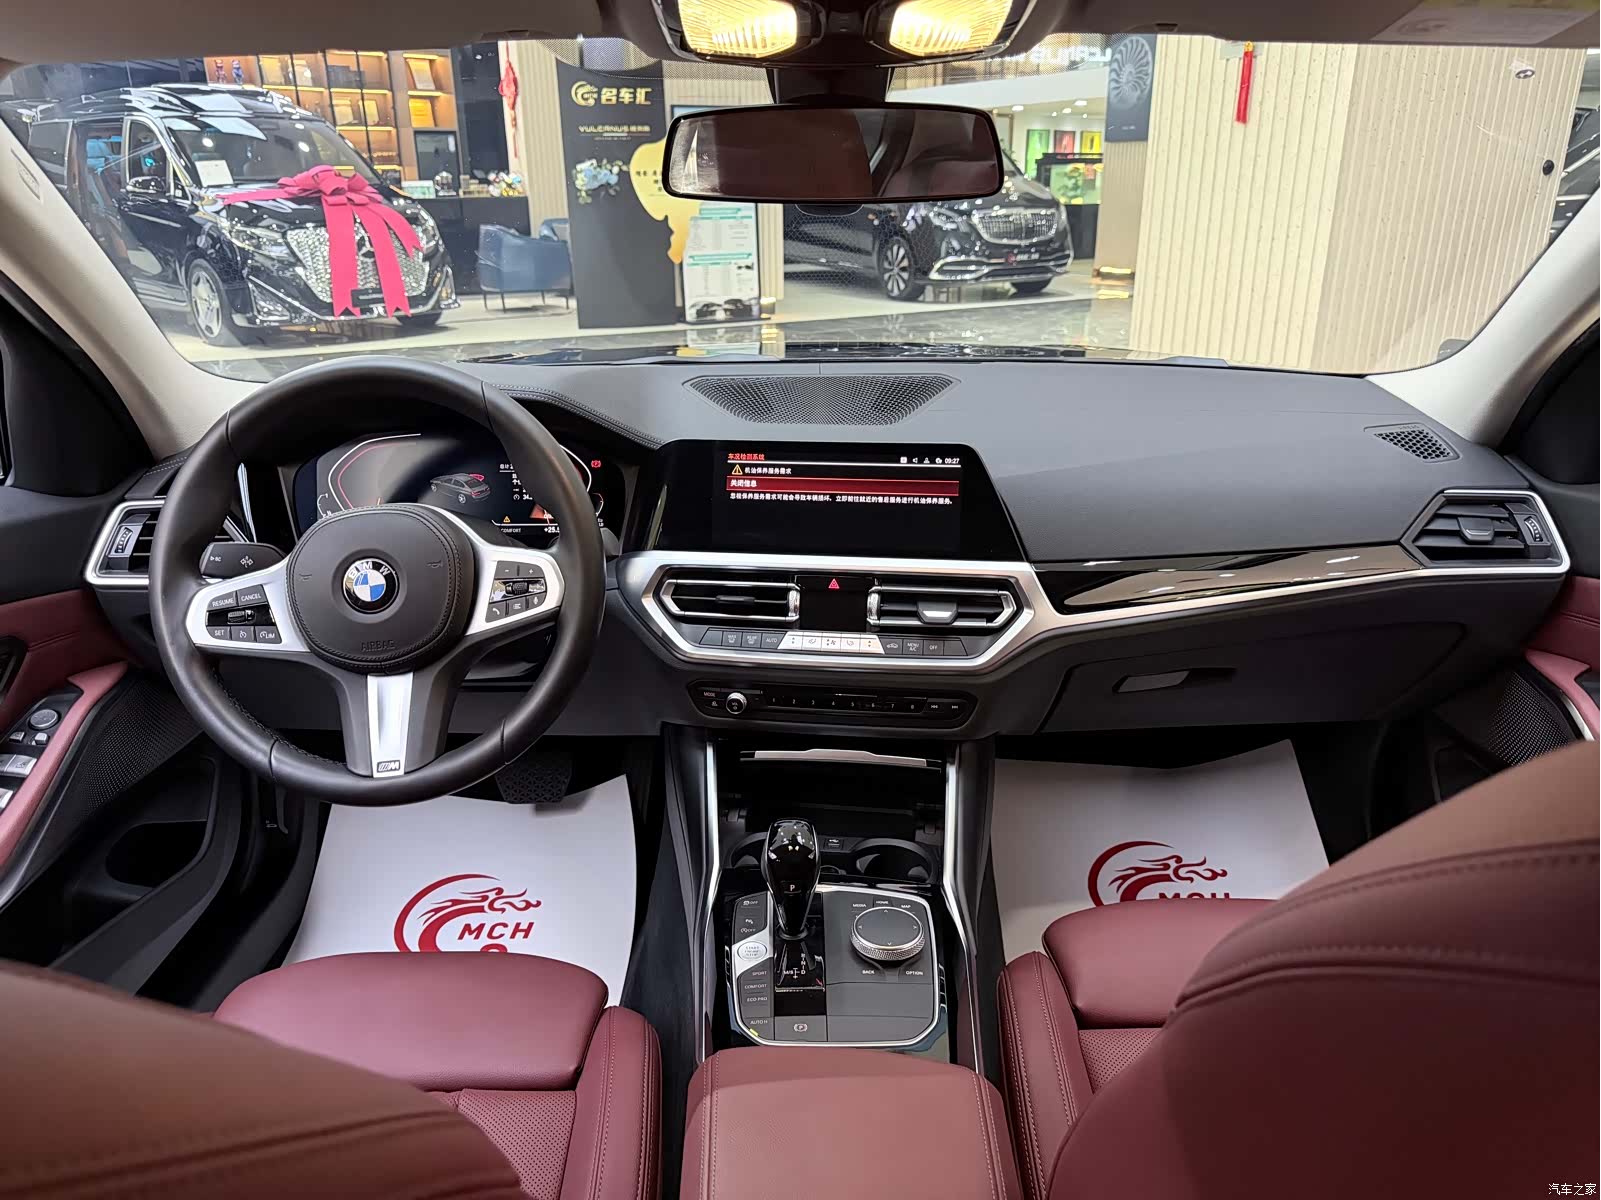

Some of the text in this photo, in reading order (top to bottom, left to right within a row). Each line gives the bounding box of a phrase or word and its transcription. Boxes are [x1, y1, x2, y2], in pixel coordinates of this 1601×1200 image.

[601, 87, 652, 105] 名车汇
[730, 479, 757, 487] 关闭信息
[348, 561, 390, 578] BMW
[211, 598, 234, 607] RESUME
[240, 593, 261, 602] CANCEL
[457, 922, 535, 941] MCH
